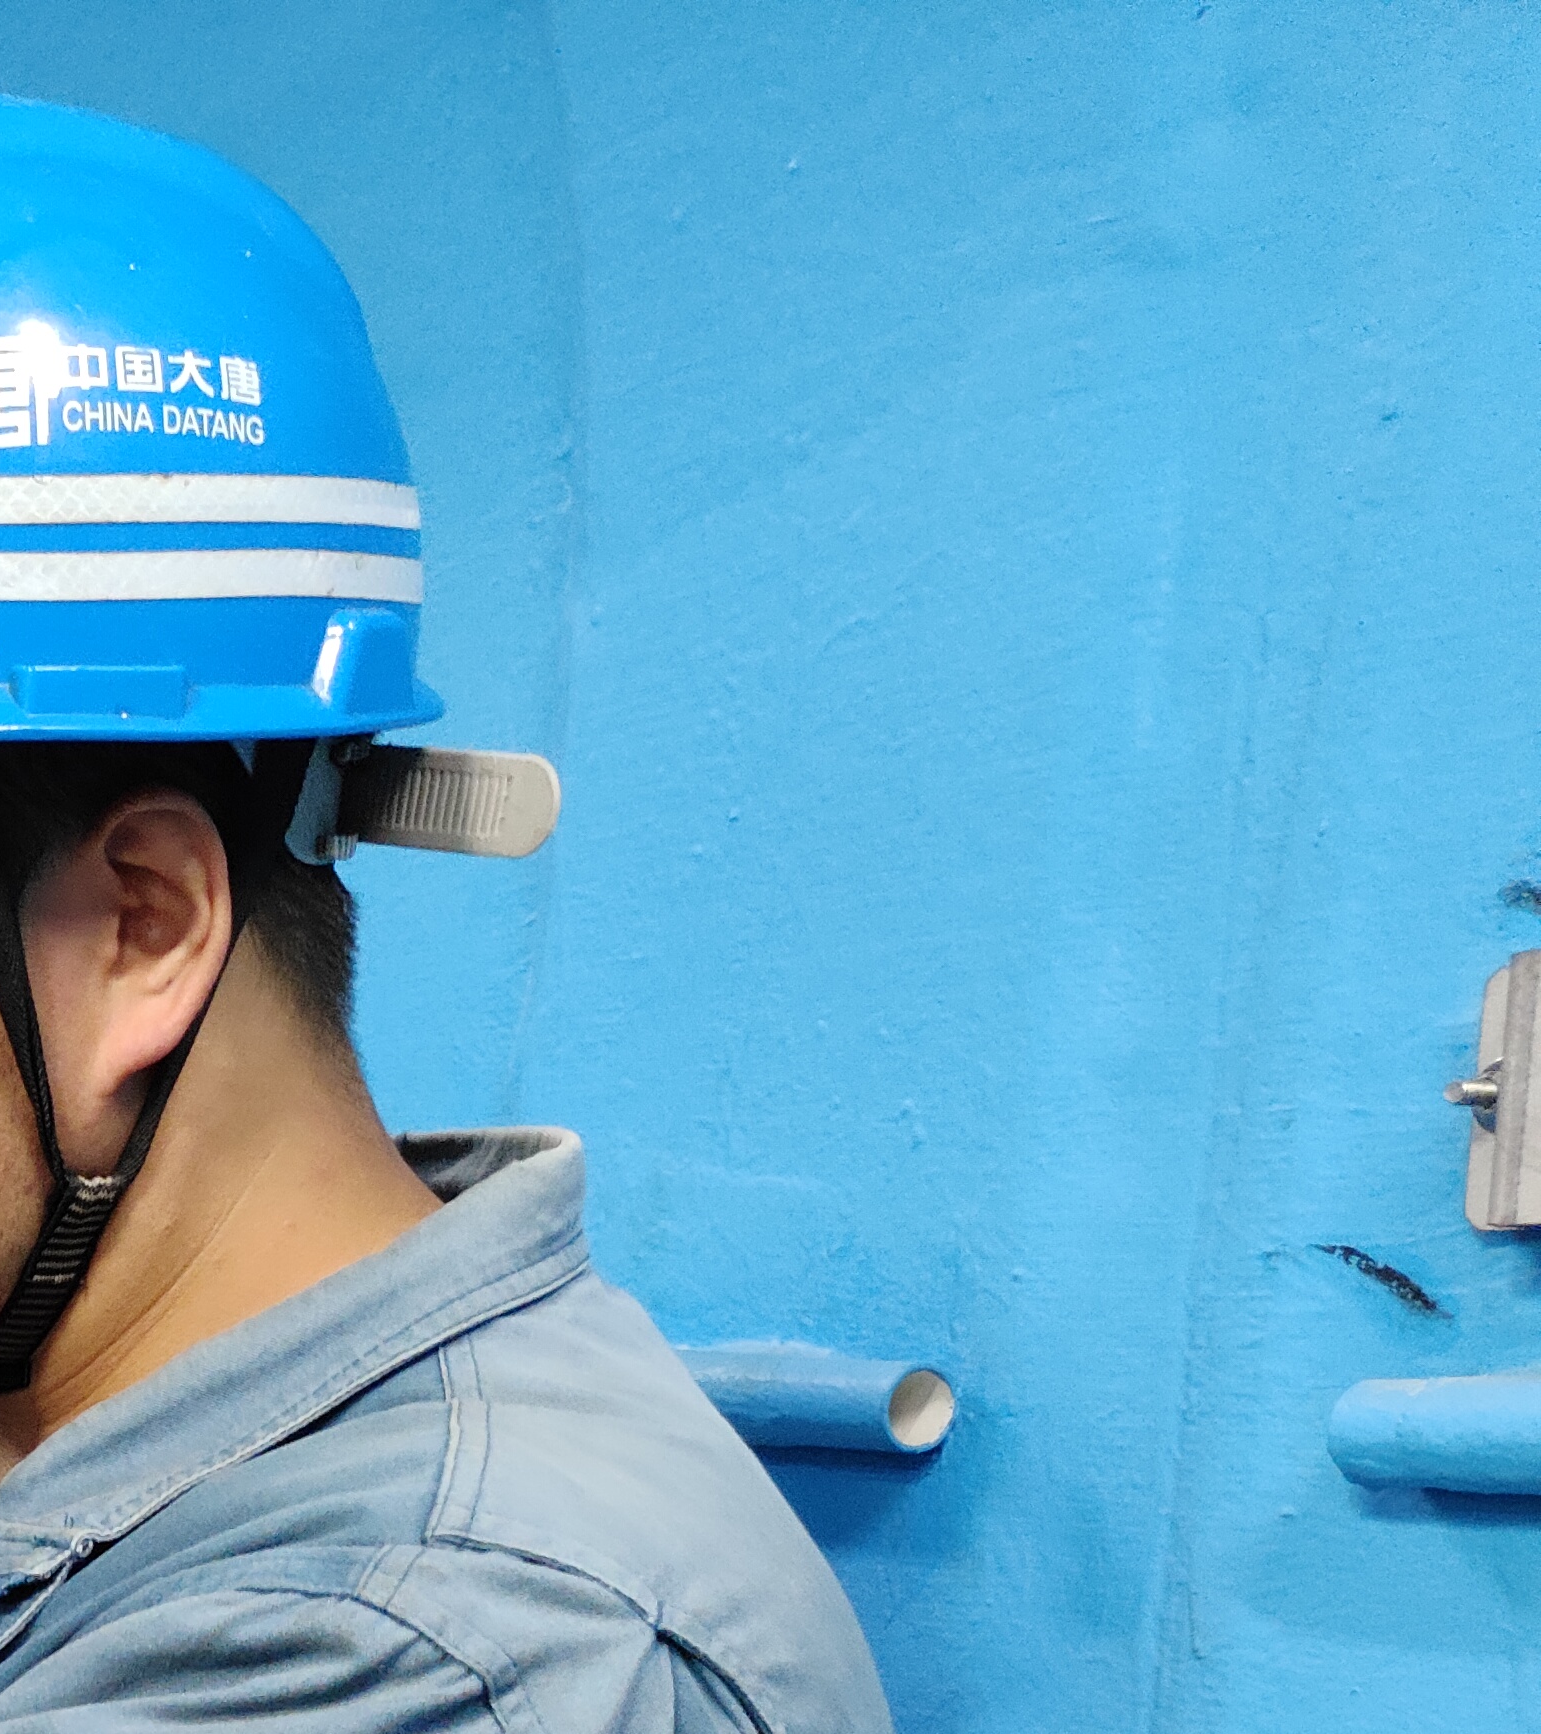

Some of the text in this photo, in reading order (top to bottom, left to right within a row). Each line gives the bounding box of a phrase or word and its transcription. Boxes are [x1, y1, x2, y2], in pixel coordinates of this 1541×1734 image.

[60, 343, 262, 406] 中国大唐
[62, 400, 266, 446] CHINA DATANG
